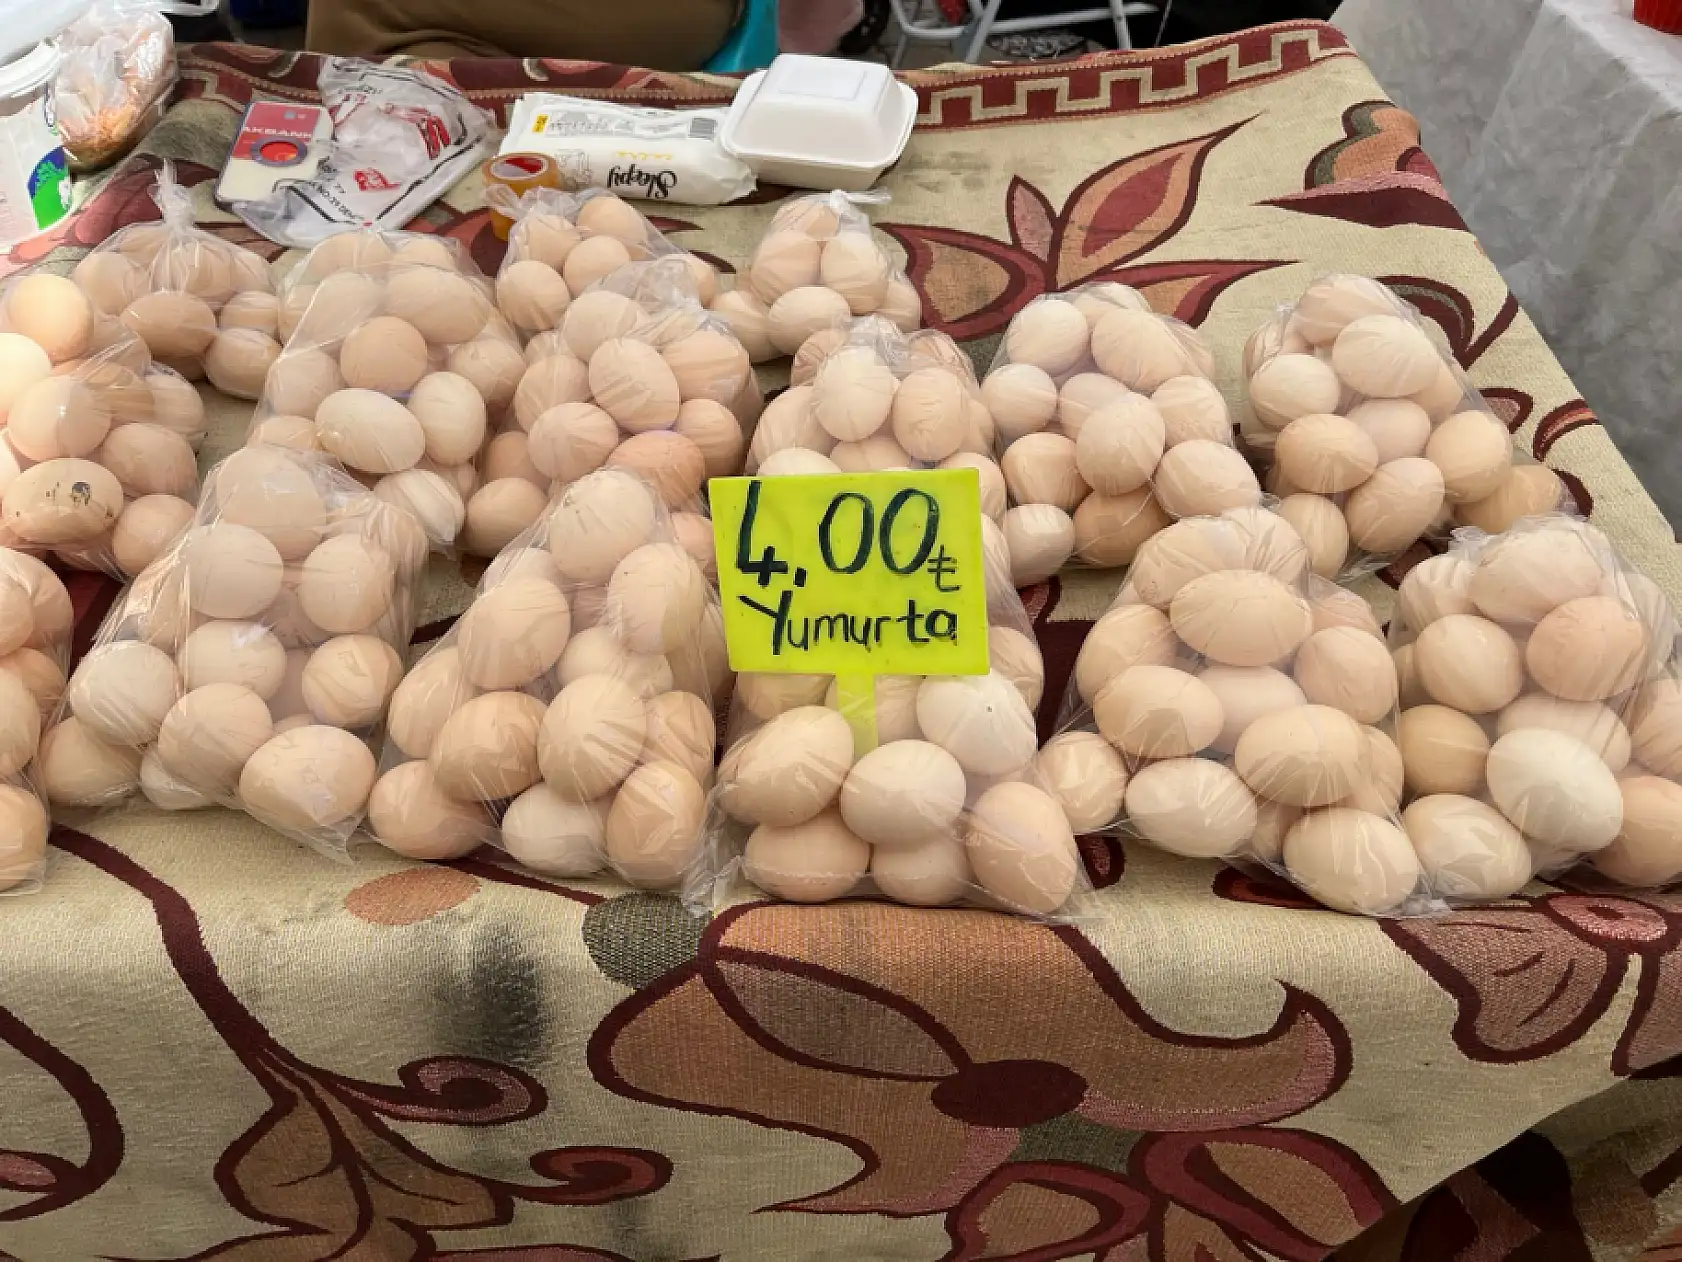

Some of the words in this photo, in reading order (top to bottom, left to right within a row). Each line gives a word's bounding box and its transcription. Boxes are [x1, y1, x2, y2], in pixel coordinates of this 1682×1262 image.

[243, 126, 312, 138] AKBANK
[607, 164, 677, 200] Sleepy
[735, 590, 959, 656] Yumurta
